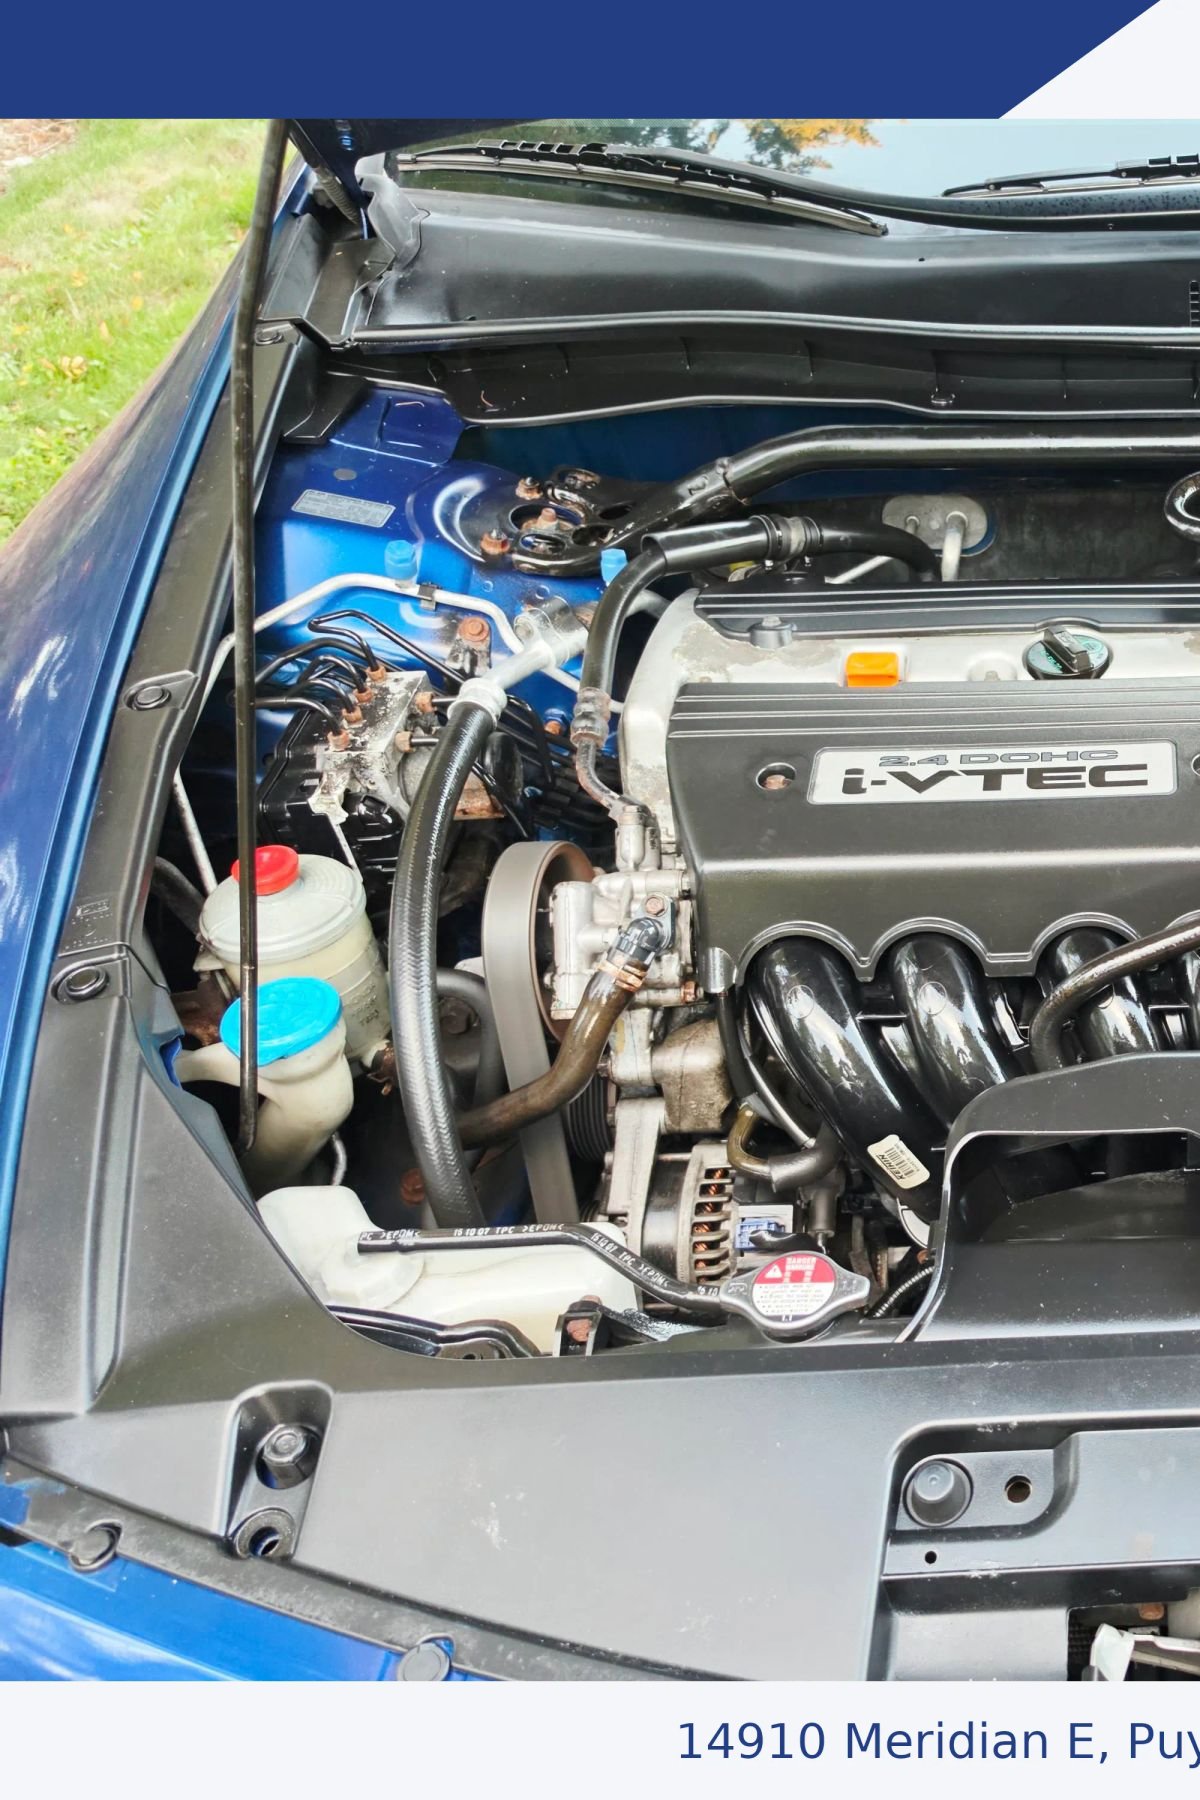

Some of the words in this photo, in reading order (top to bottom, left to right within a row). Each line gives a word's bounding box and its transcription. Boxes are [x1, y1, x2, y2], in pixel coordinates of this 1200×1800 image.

[879, 754, 949, 767] 2.4
[959, 750, 1118, 765] DOHC
[841, 763, 1148, 795] i-VTEC
